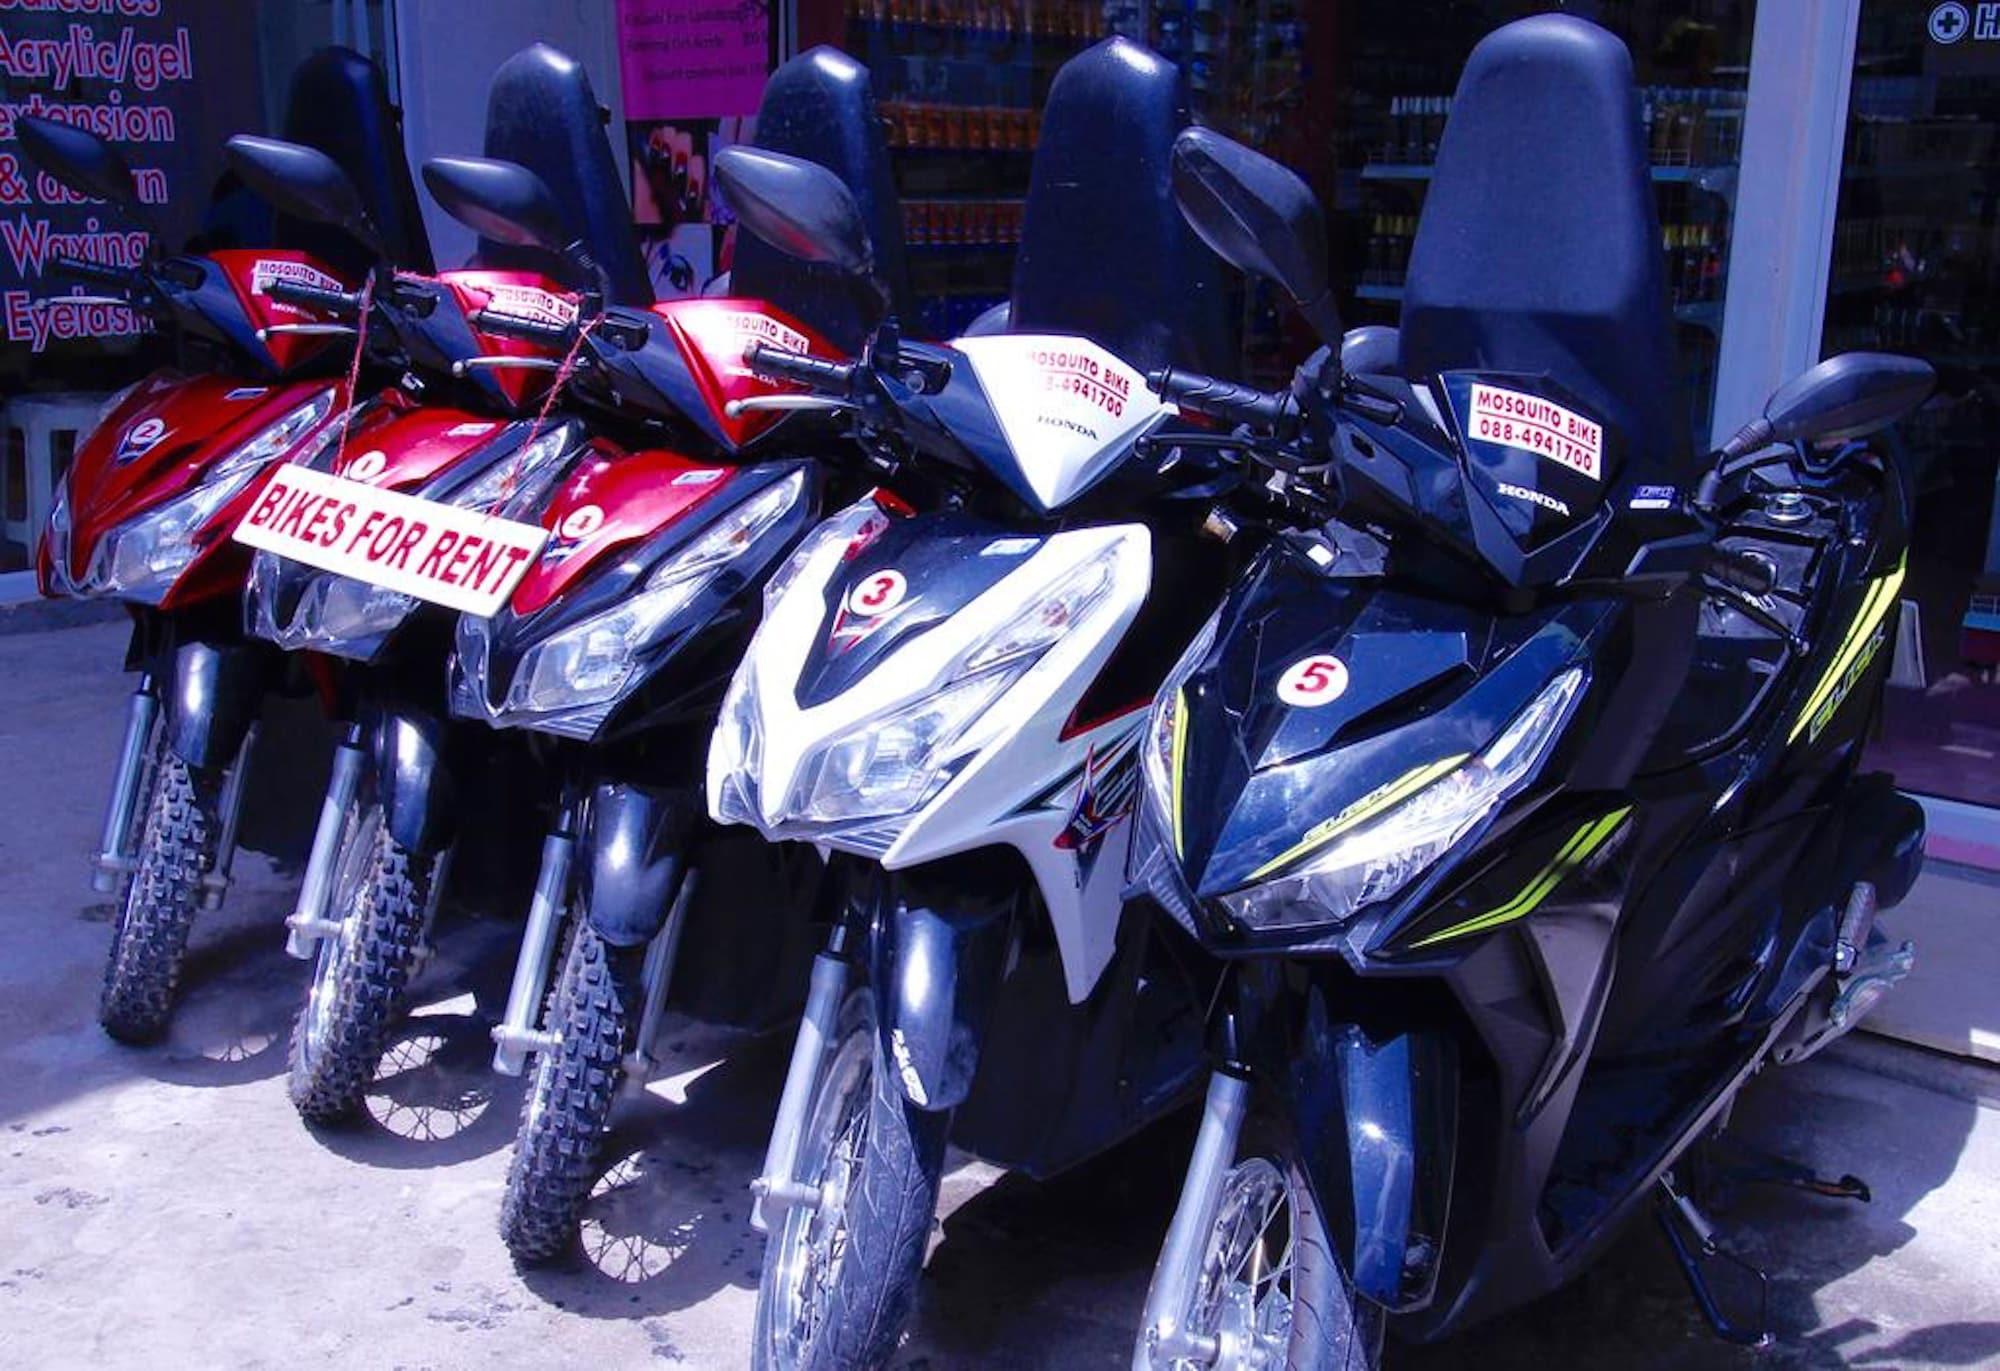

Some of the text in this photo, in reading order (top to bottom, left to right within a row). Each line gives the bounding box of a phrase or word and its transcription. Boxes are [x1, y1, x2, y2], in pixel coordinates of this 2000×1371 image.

[260, 263, 315, 281] MOSQUITO
[1103, 368, 1130, 395] BIKE
[136, 424, 157, 438] 2
[1037, 415, 1098, 440] HONDA
[1477, 390, 1598, 446] MOSQUITO BIKE
[1479, 418, 1593, 471] 088-4941700
[1498, 482, 1571, 517] HONDA
[249, 482, 532, 596] BIKES FOR RENT
[861, 576, 895, 606] 3
[1294, 661, 1337, 694] 5
